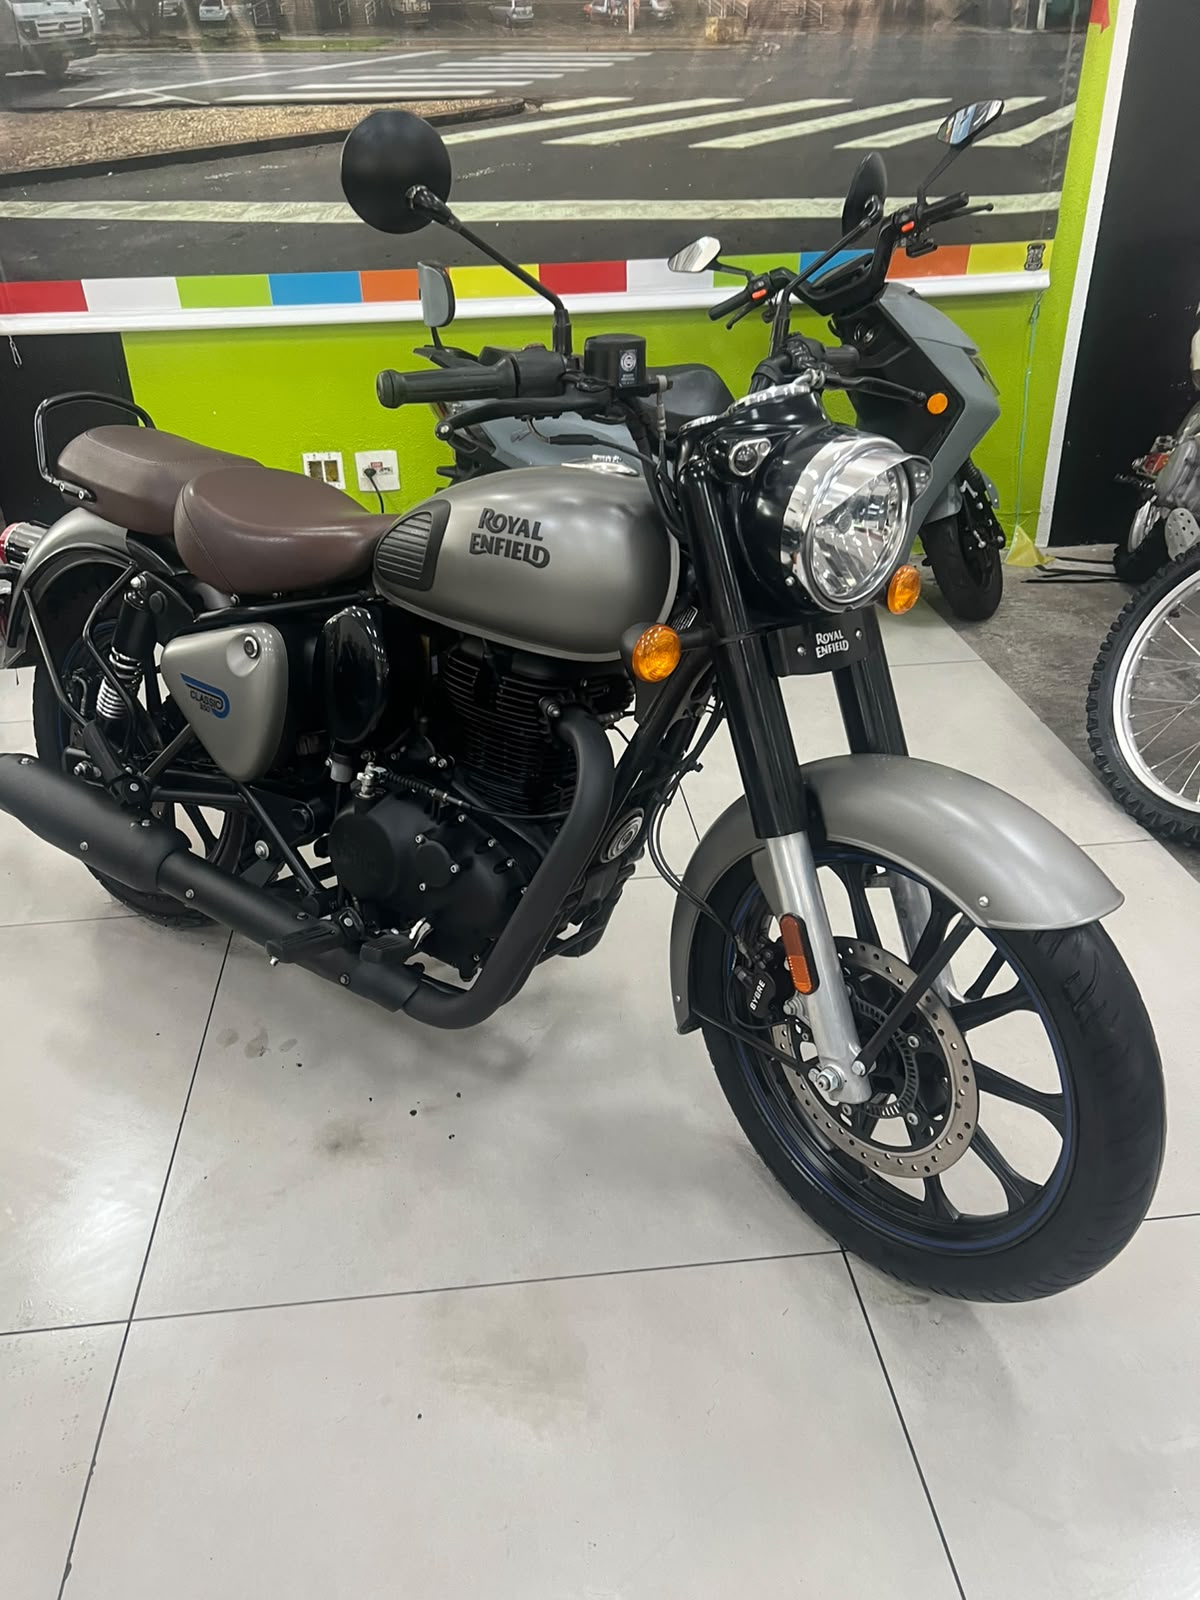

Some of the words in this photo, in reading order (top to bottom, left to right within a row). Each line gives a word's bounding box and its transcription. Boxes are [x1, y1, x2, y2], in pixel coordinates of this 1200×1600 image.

[478, 507, 543, 541] ROYAL
[469, 532, 550, 569] ENFIELD
[815, 630, 844, 645] ROYAL
[815, 640, 849, 658] ENFIELD
[190, 690, 224, 710] CLASSIC
